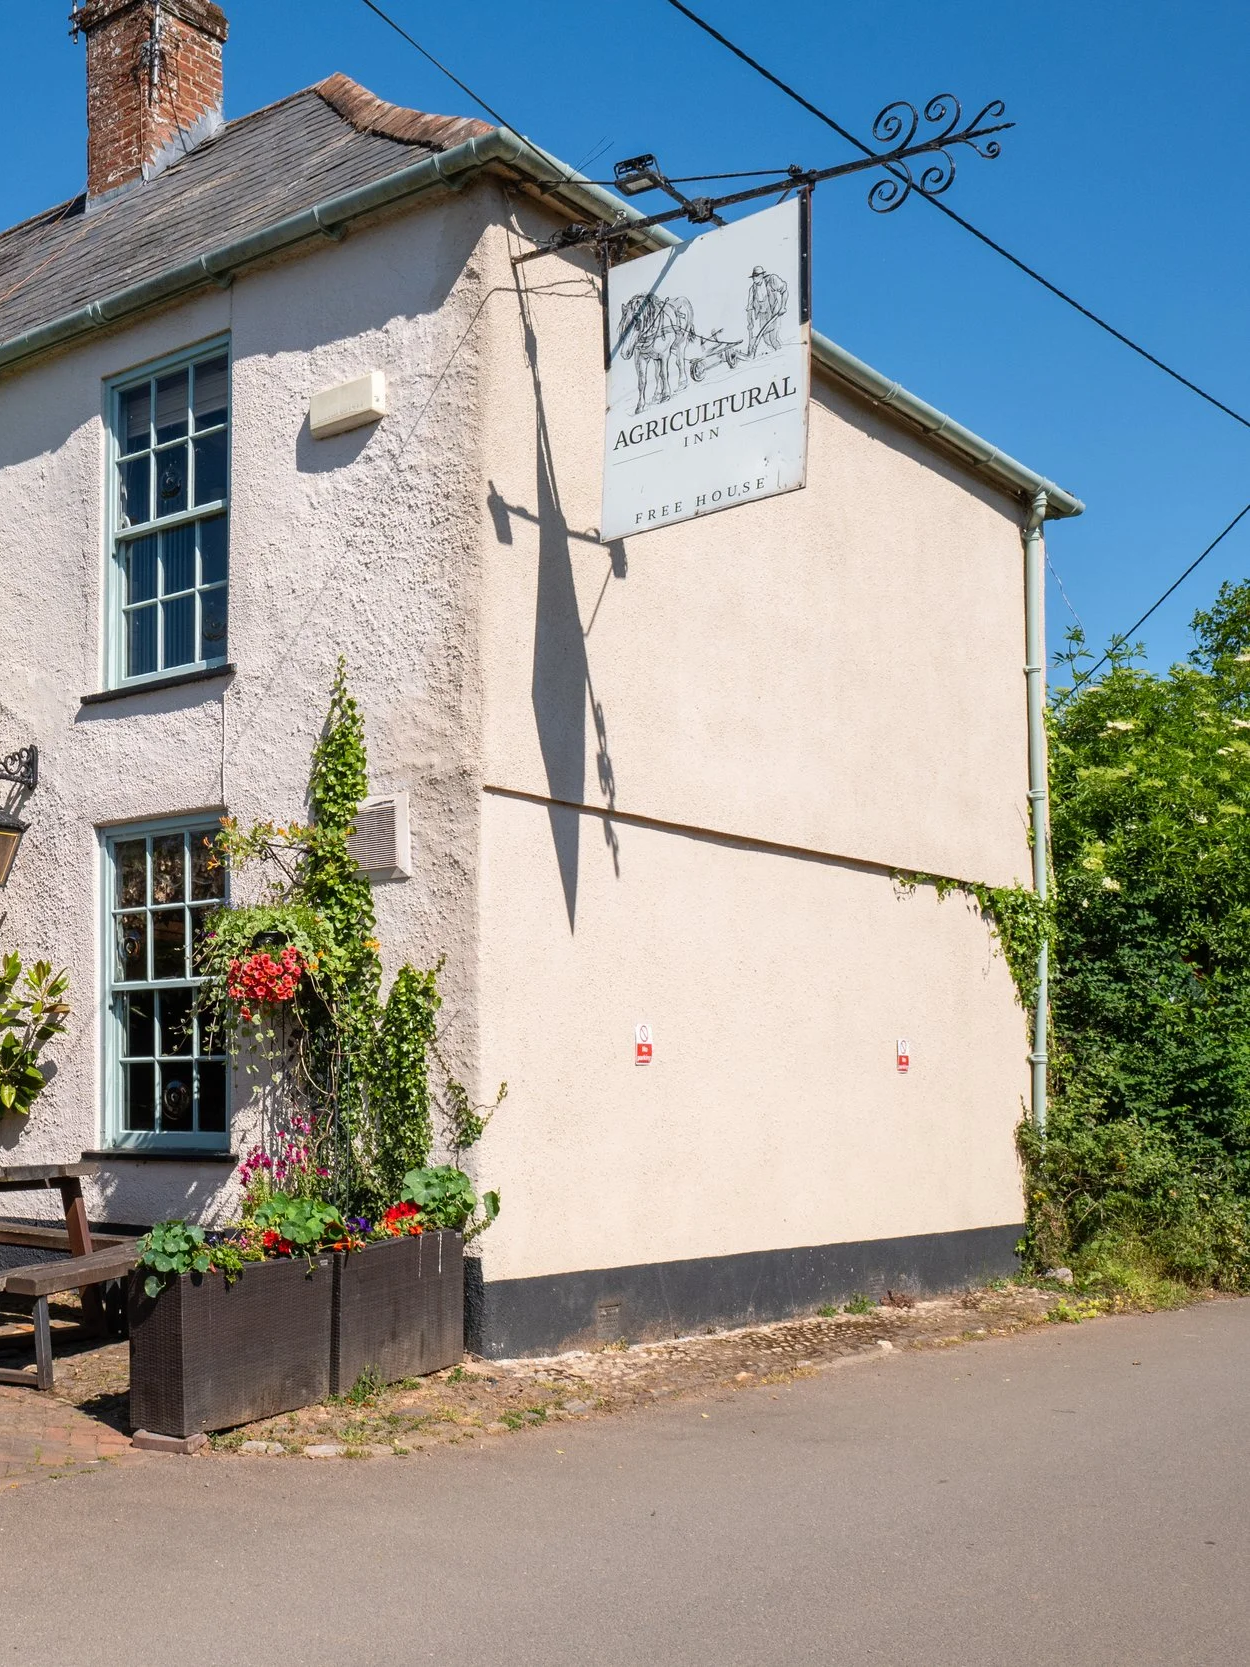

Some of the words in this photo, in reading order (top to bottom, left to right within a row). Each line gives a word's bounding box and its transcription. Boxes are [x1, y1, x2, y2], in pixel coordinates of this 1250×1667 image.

[613, 376, 797, 450] AGRICULTURAL
[684, 426, 720, 447] INN
[635, 501, 683, 524] FREE
[696, 477, 765, 507] HOUSE
